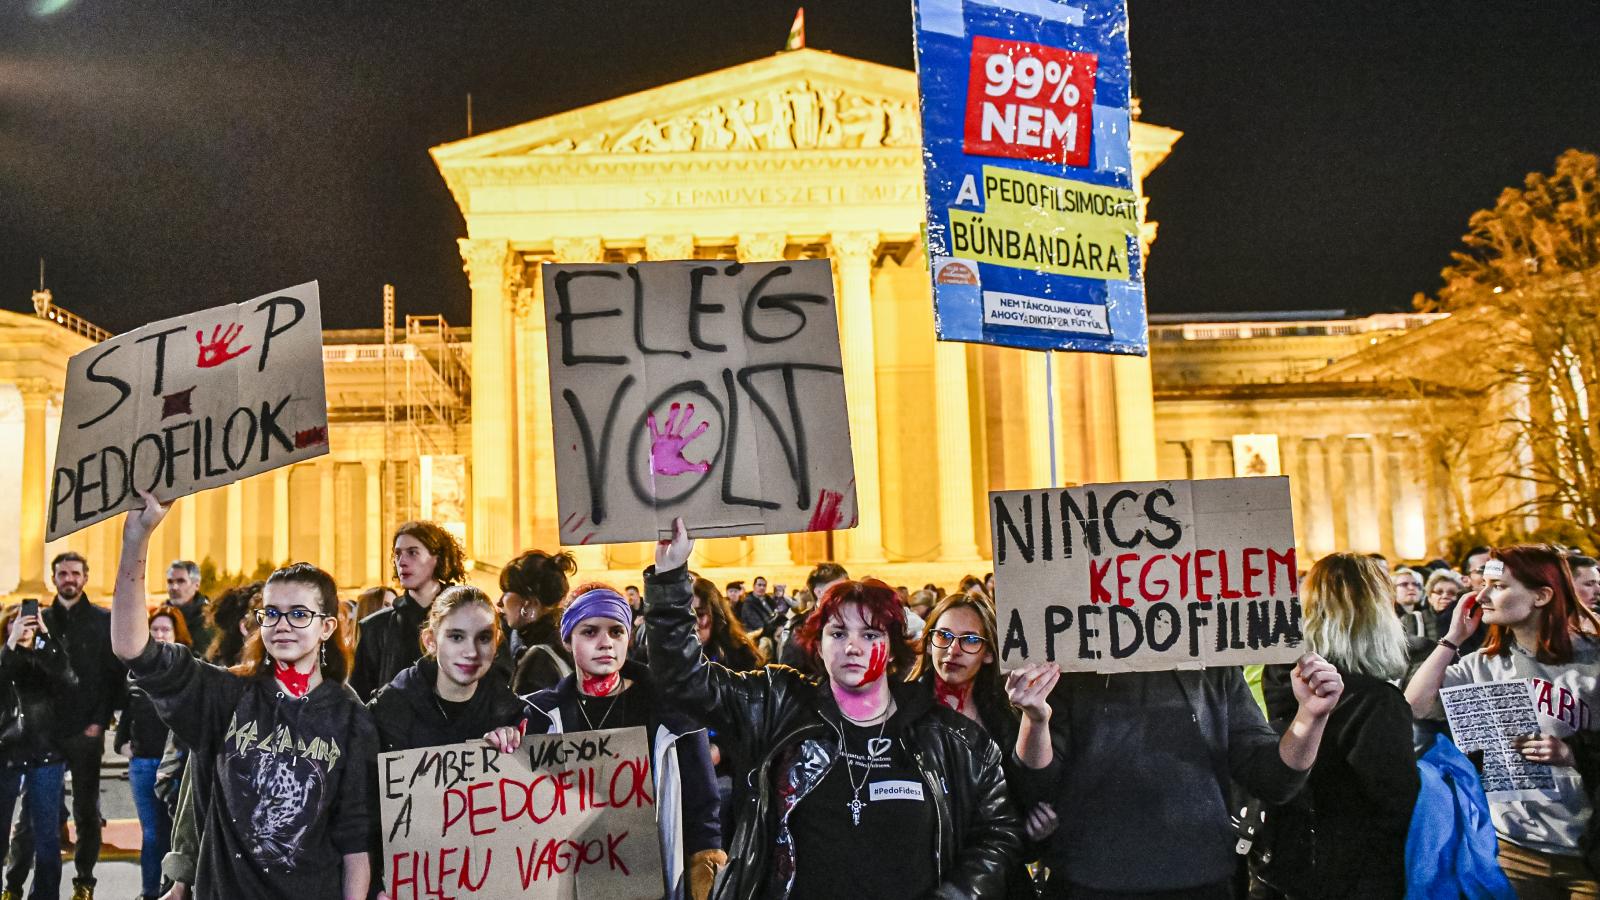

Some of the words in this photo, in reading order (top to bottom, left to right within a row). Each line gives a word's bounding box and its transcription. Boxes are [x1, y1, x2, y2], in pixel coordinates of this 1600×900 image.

[984, 54, 1080, 108] 99%
[981, 102, 1079, 152] NEM
[955, 173, 981, 206] A
[986, 176, 1138, 221] PEDOFILSIMOGAT
[952, 218, 1122, 274] BŰNBANDÁRA
[990, 310, 1024, 321] AHOGY
[1000, 298, 1020, 308] NEM
[1022, 299, 1072, 314] TÁNCOLUNK
[49, 394, 297, 533] PEDOFILOK
[562, 363, 842, 526] VOLT
[994, 488, 1183, 565] NINCS
[1089, 547, 1298, 607] KEGYELEM
[1002, 608, 1029, 662] A
[385, 746, 501, 799] EMBER
[389, 793, 413, 843] A
[442, 755, 655, 838] PEDOFILOK
[516, 830, 630, 891] VAGYOK
